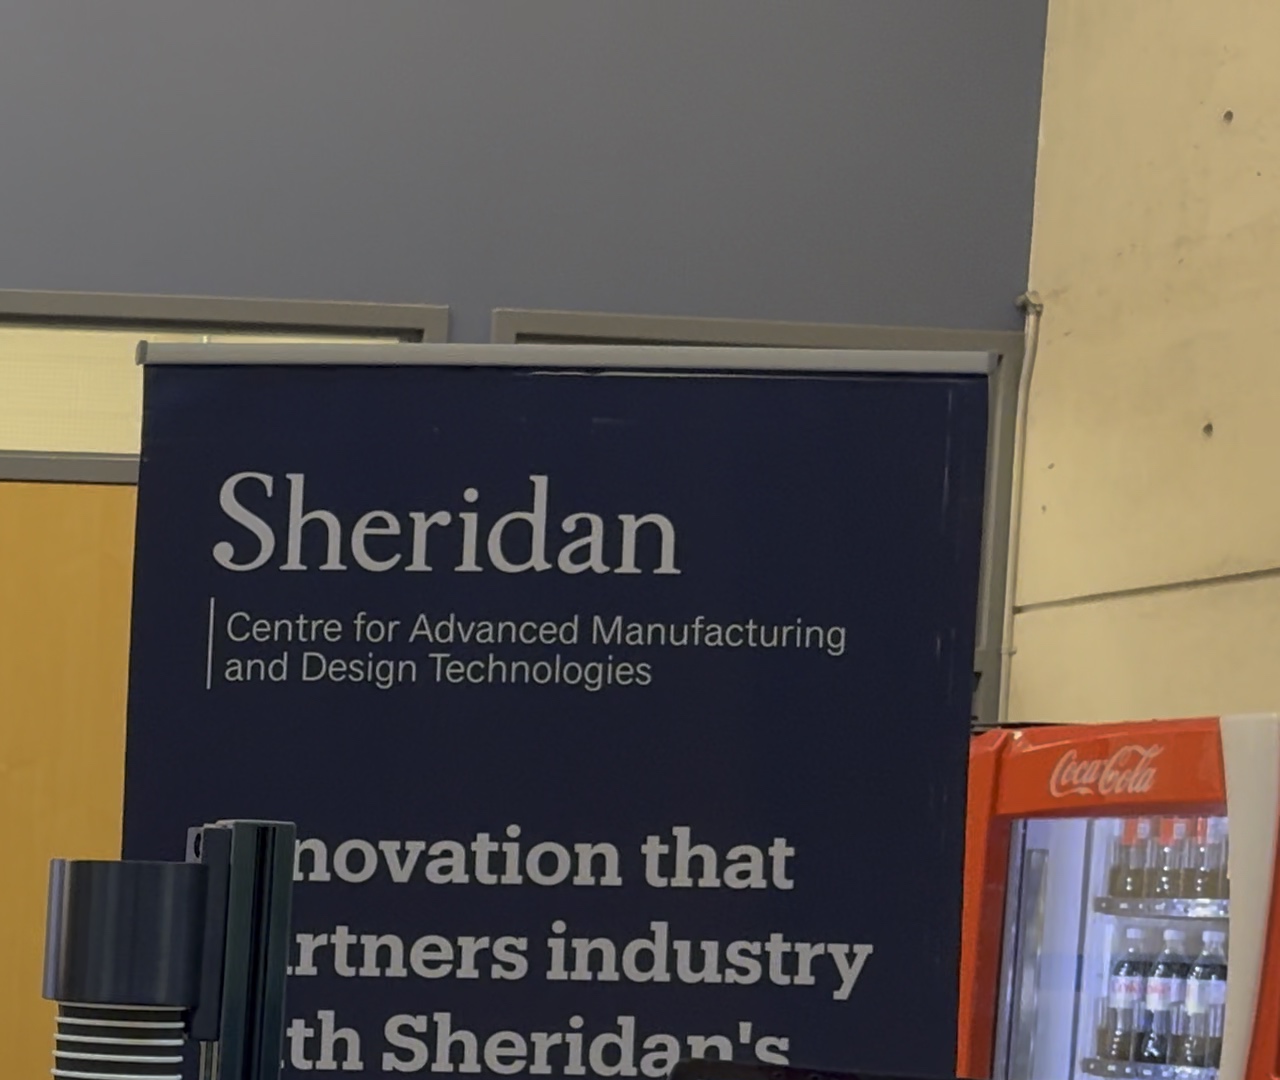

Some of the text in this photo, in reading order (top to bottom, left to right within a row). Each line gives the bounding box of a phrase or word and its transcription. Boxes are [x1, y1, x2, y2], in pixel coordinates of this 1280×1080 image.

[212, 471, 682, 575] Sheridan
[226, 612, 848, 657] Centre for Advanced Manufacturing
[224, 653, 653, 693] and Design Technologies
[641, 825, 796, 891] that
[287, 919, 874, 1001] rtners industry
[382, 1012, 790, 1078] Sheridan's
